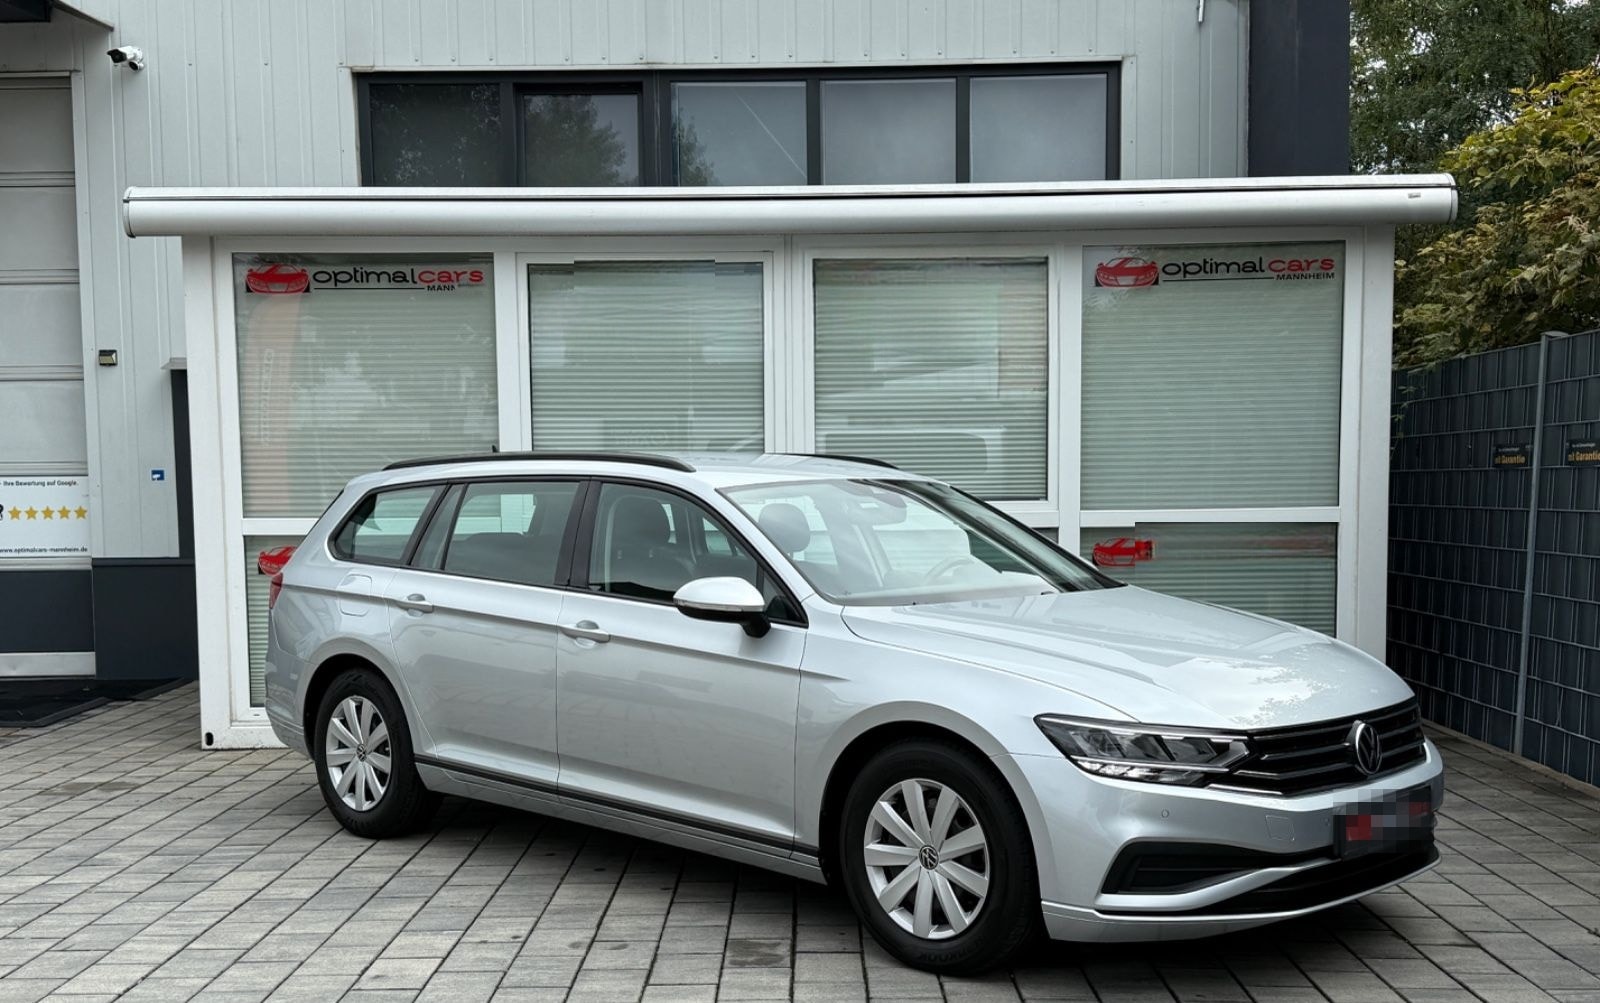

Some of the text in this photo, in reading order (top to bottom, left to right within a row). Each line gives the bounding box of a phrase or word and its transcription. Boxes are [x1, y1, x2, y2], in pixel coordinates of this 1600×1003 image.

[1276, 272, 1335, 281] MANNHEIM
[15, 480, 46, 488] Bewertung
[46, 479, 56, 487] auf
